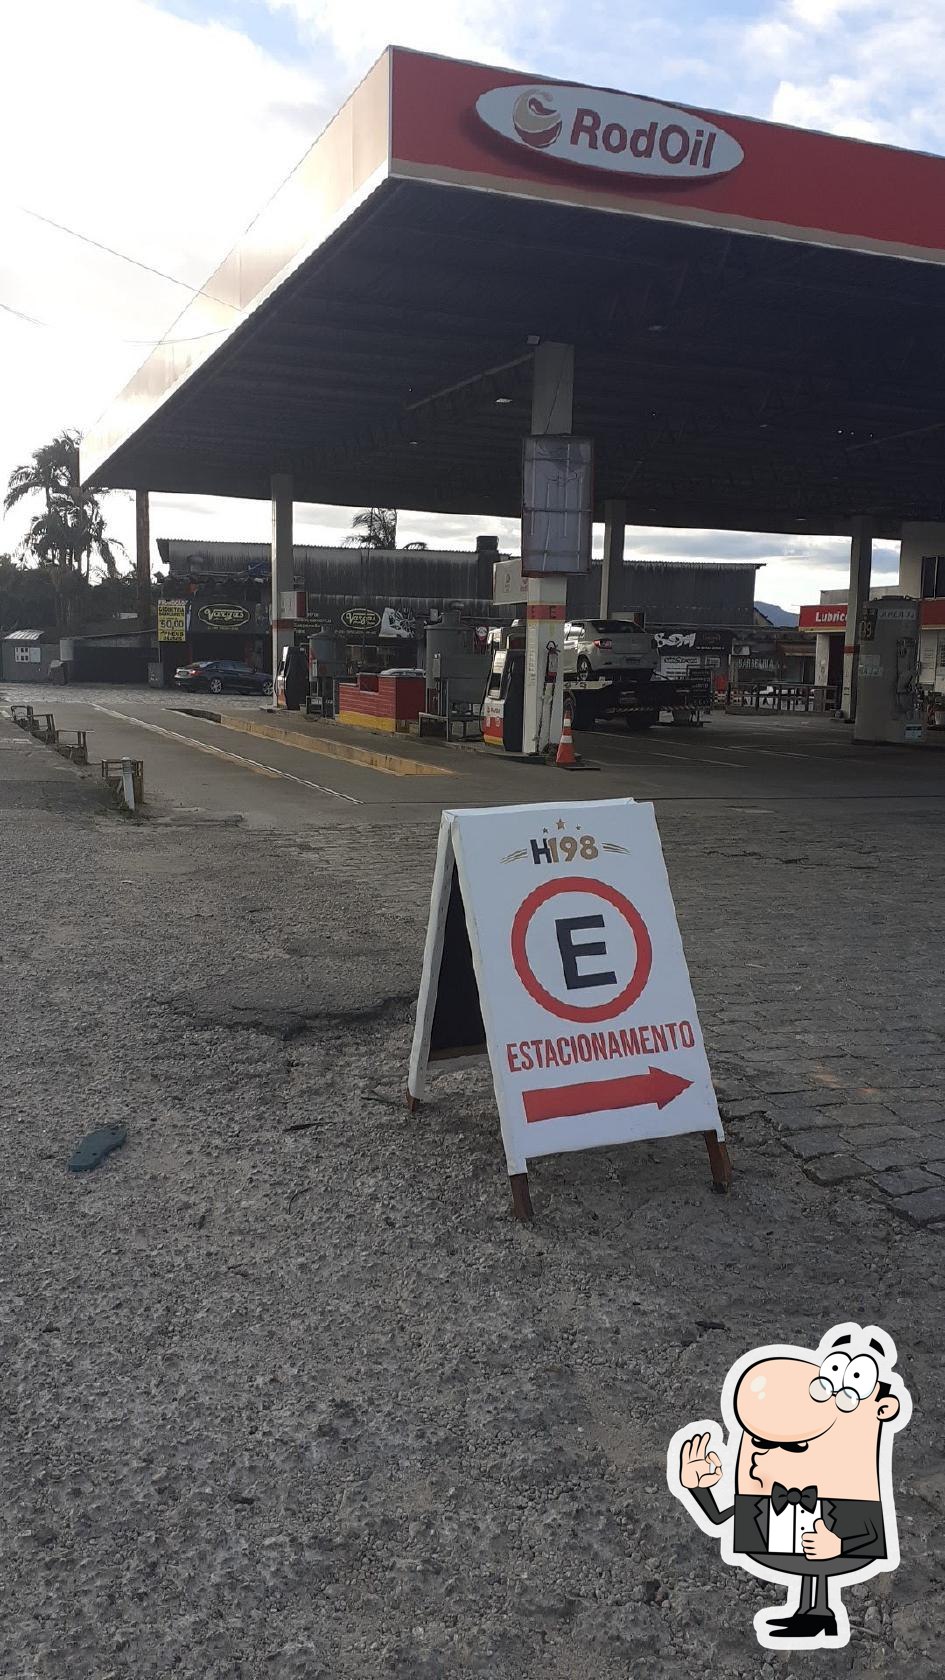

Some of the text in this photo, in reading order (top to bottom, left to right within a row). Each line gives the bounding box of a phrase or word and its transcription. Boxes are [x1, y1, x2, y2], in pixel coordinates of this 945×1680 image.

[569, 107, 717, 169] RodOil
[204, 608, 244, 621] Vargas
[345, 612, 376, 625] Vargas
[529, 834, 600, 865] H198
[554, 914, 618, 990] E
[506, 1020, 696, 1073] ESTACIONAMENTO
